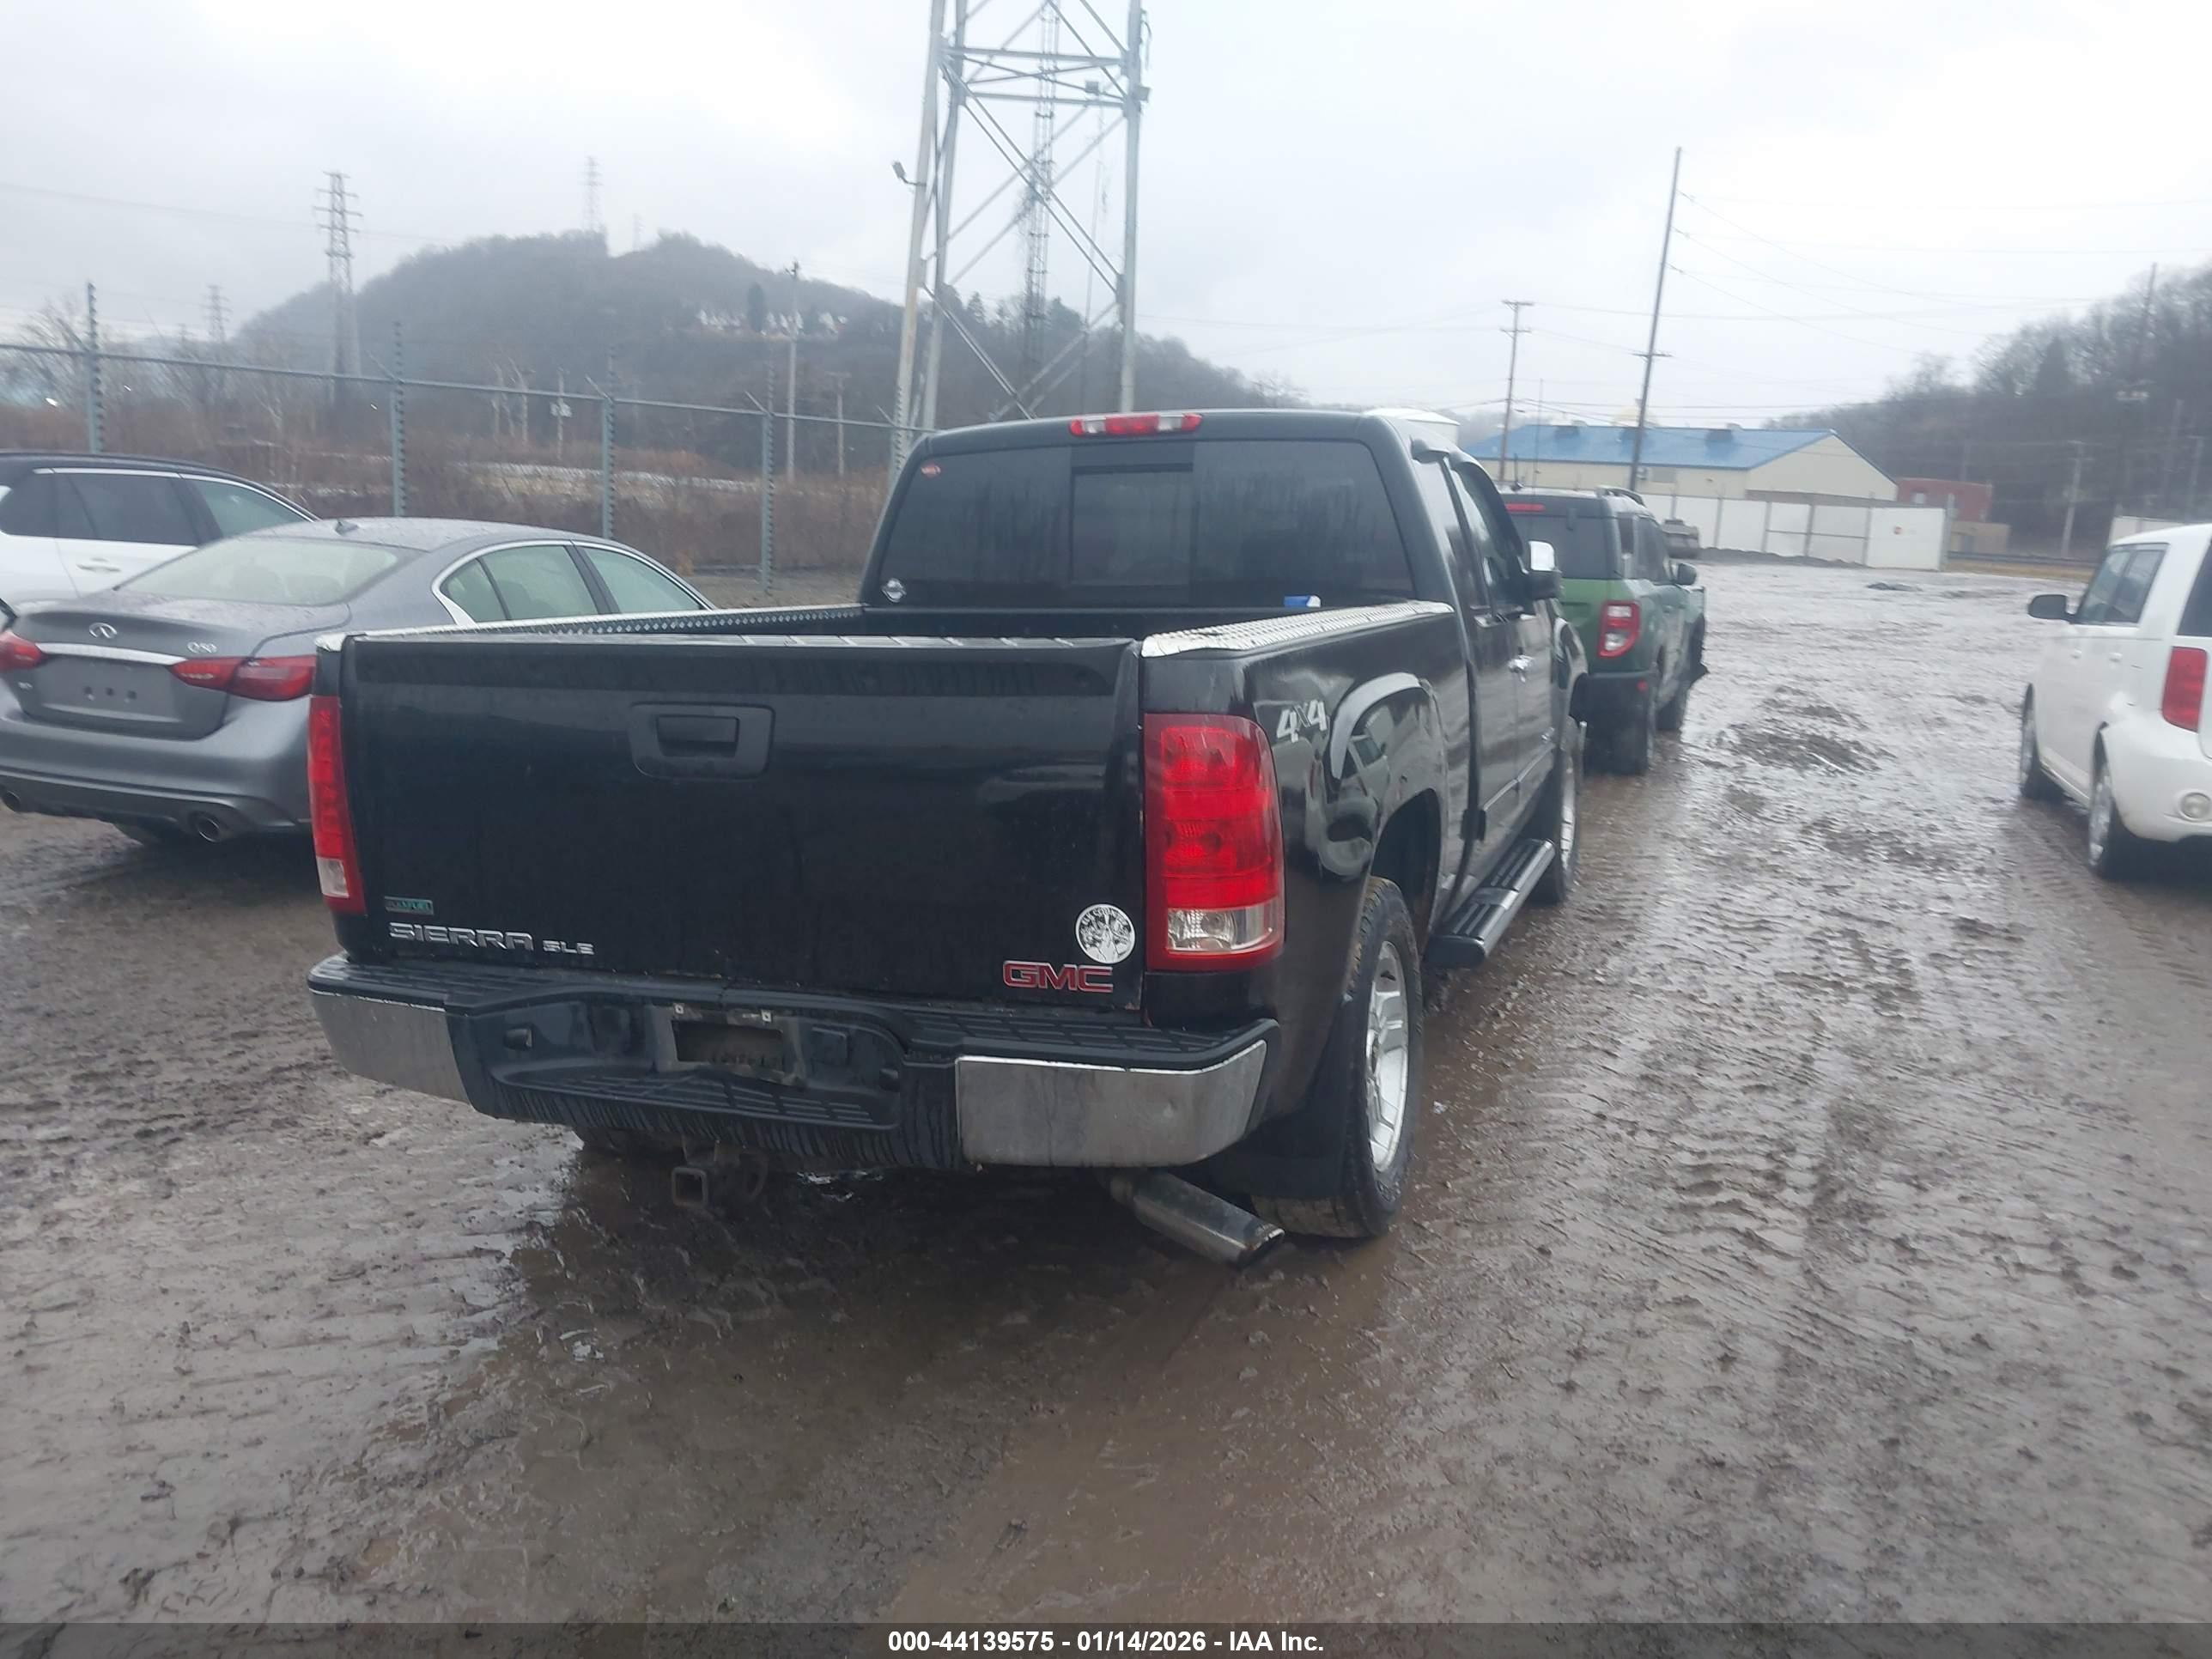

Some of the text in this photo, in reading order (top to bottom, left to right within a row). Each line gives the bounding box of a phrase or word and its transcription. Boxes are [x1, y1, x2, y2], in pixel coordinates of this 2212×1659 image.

[389, 922, 595, 955] SIERRA SLE
[1003, 960, 1114, 993] GMC
